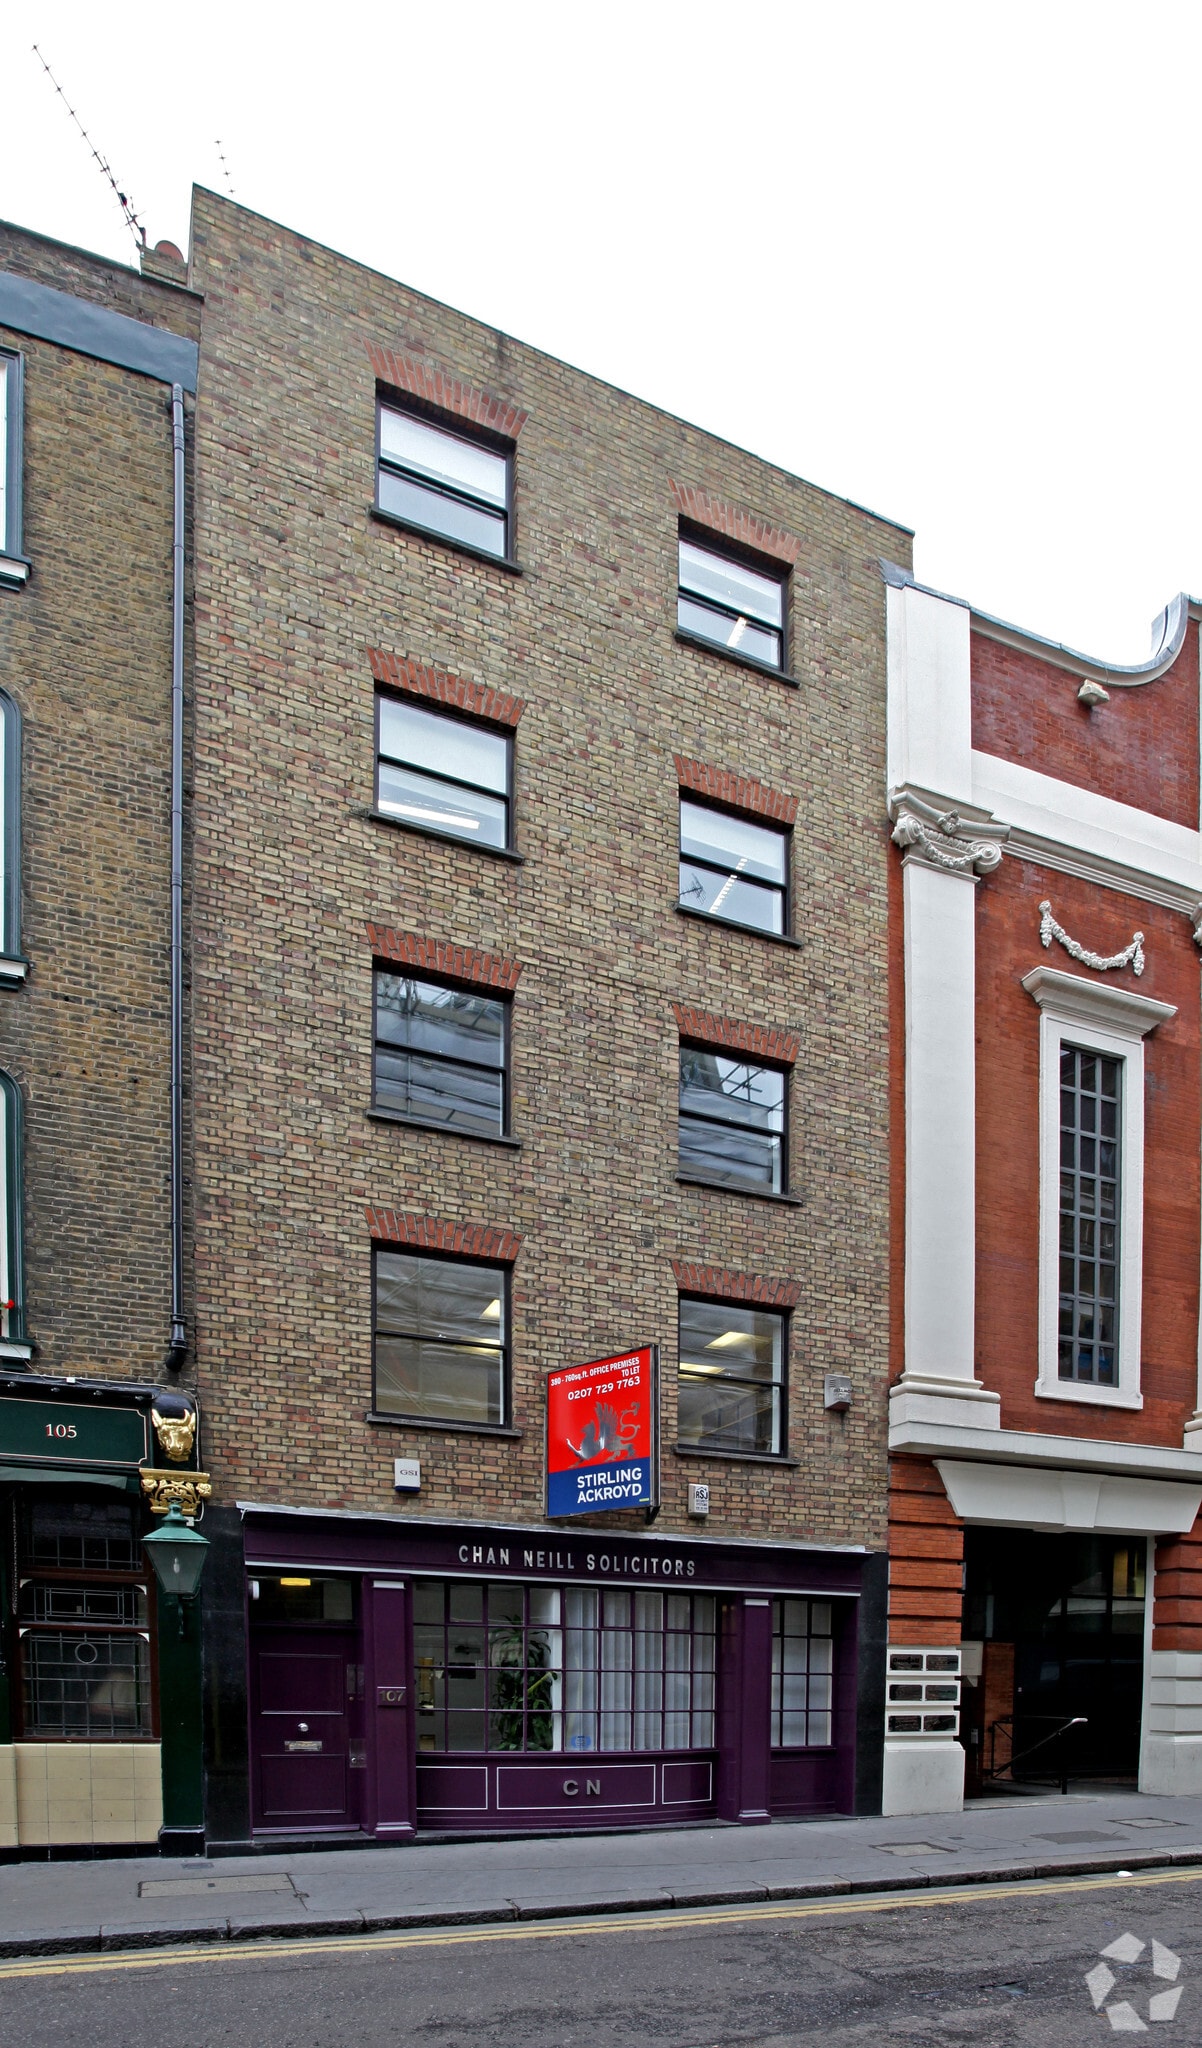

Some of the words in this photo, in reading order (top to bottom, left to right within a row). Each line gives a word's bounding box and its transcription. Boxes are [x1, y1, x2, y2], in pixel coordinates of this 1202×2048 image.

[590, 1365, 609, 1377] OFFICE
[610, 1357, 640, 1371] PREMISES
[621, 1369, 629, 1377] TO
[630, 1366, 640, 1375] LET
[568, 1387, 592, 1400] 0207
[595, 1383, 614, 1394] 729
[616, 1376, 640, 1389] 7763
[45, 1423, 77, 1439] 105
[577, 1467, 642, 1488] STIRLING
[577, 1483, 642, 1503] ACKROYD
[458, 1545, 510, 1565] CHAN
[524, 1550, 575, 1570] NEILL
[586, 1553, 695, 1576] SOLICITORS
[379, 1690, 405, 1702] 107
